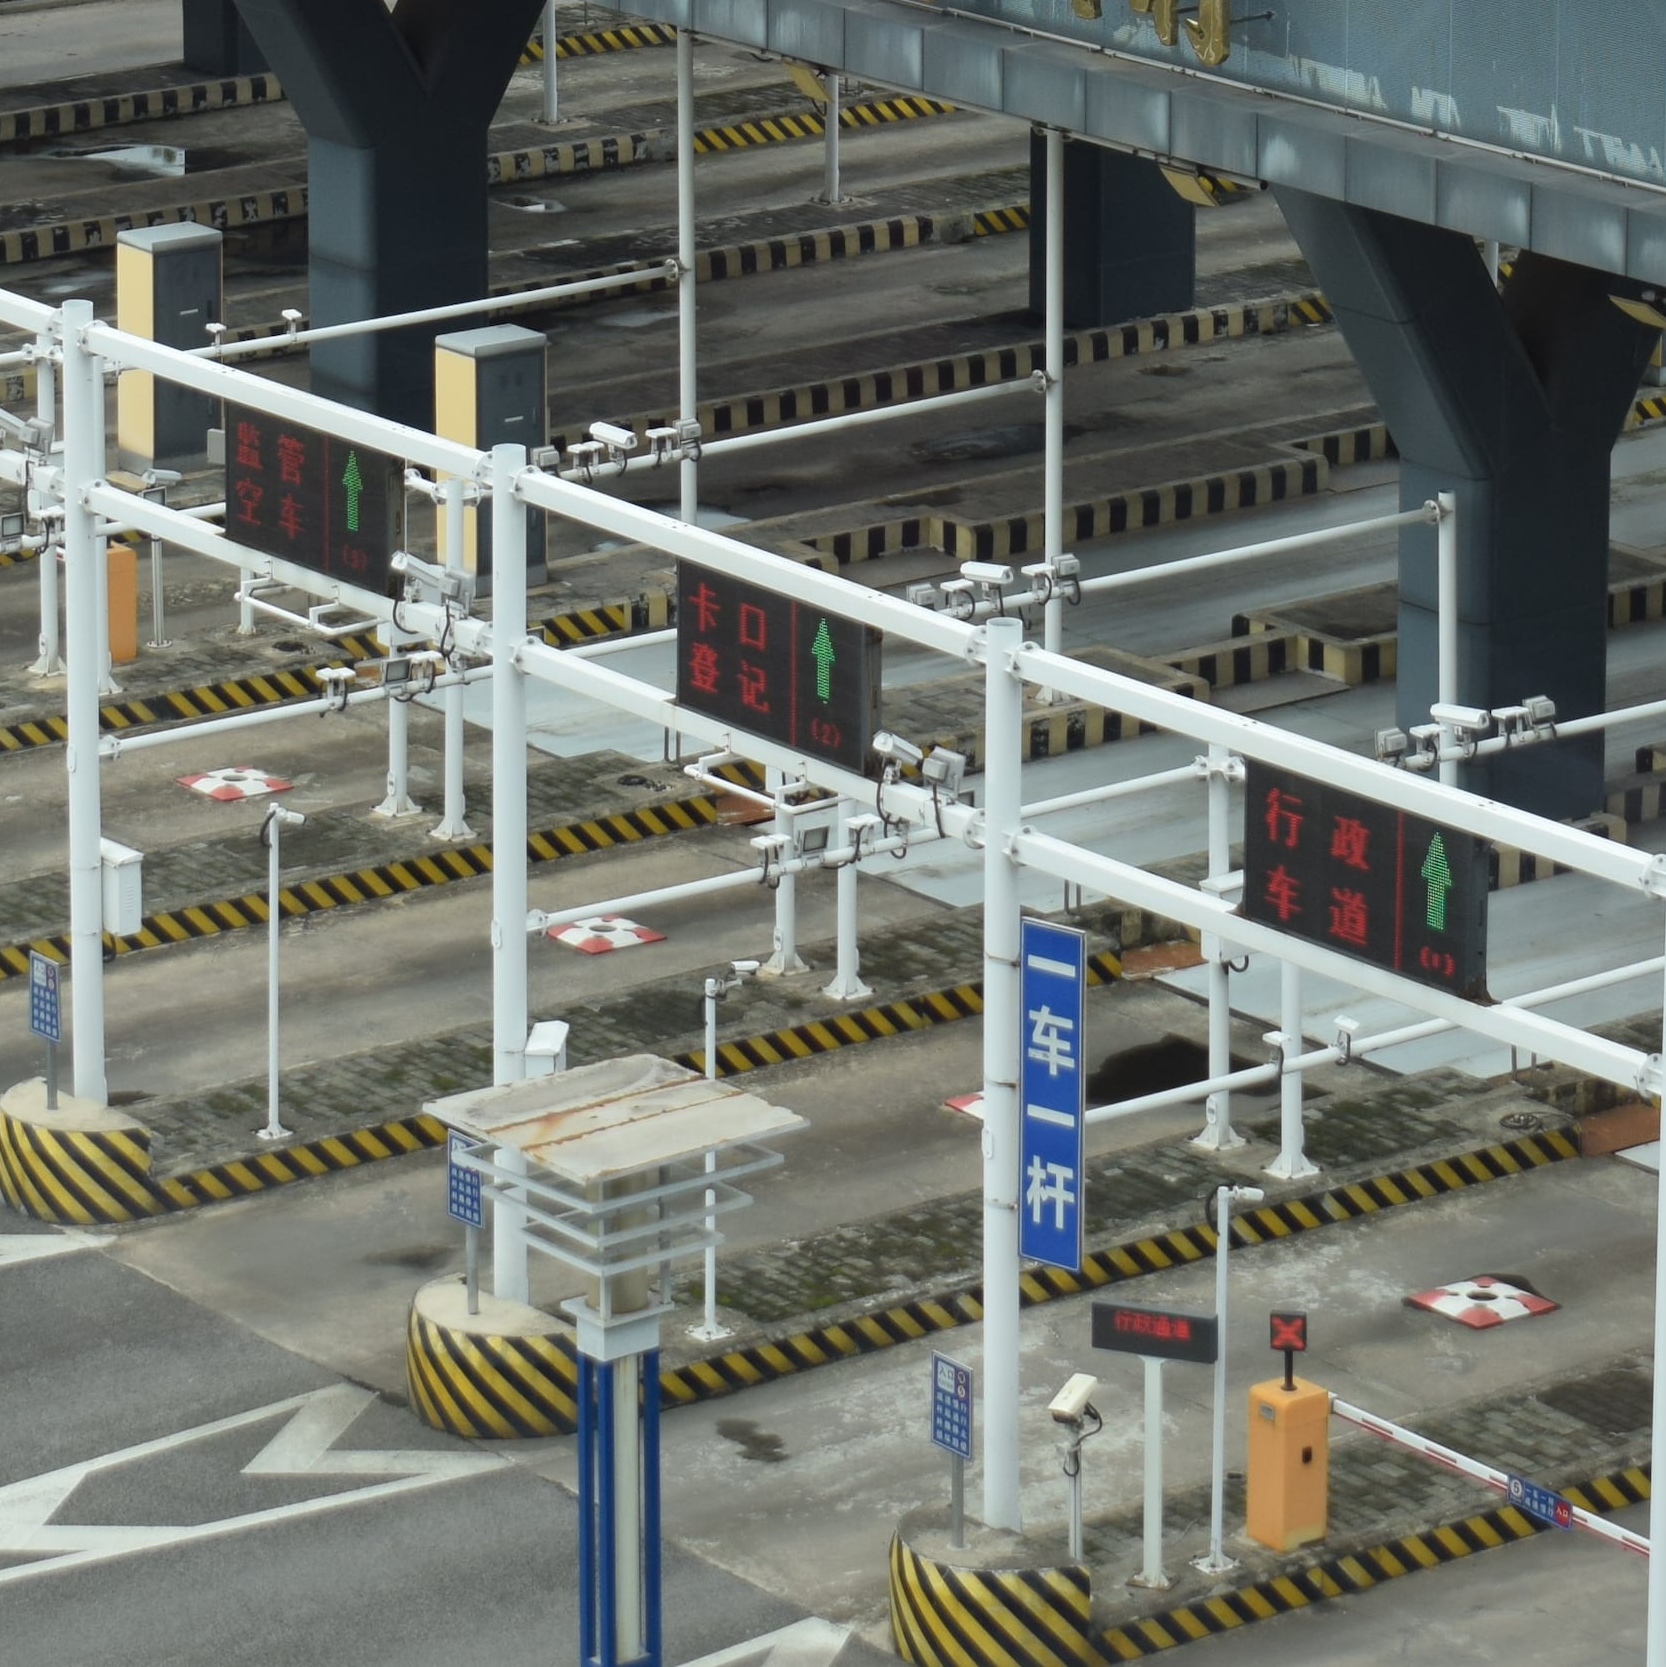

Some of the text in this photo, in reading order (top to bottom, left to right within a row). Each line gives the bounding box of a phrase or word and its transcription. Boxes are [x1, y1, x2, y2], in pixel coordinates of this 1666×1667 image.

[235, 478, 306, 540] 空车
[688, 581, 768, 652] 卡口
[688, 642, 770, 713] 登记
[810, 716, 842, 749] (2)
[1264, 787, 1372, 871] 行政
[1263, 864, 1369, 947] 车道
[1026, 953, 1076, 1231] 一车一杆
[1556, 1505, 1569, 1518] 入口
